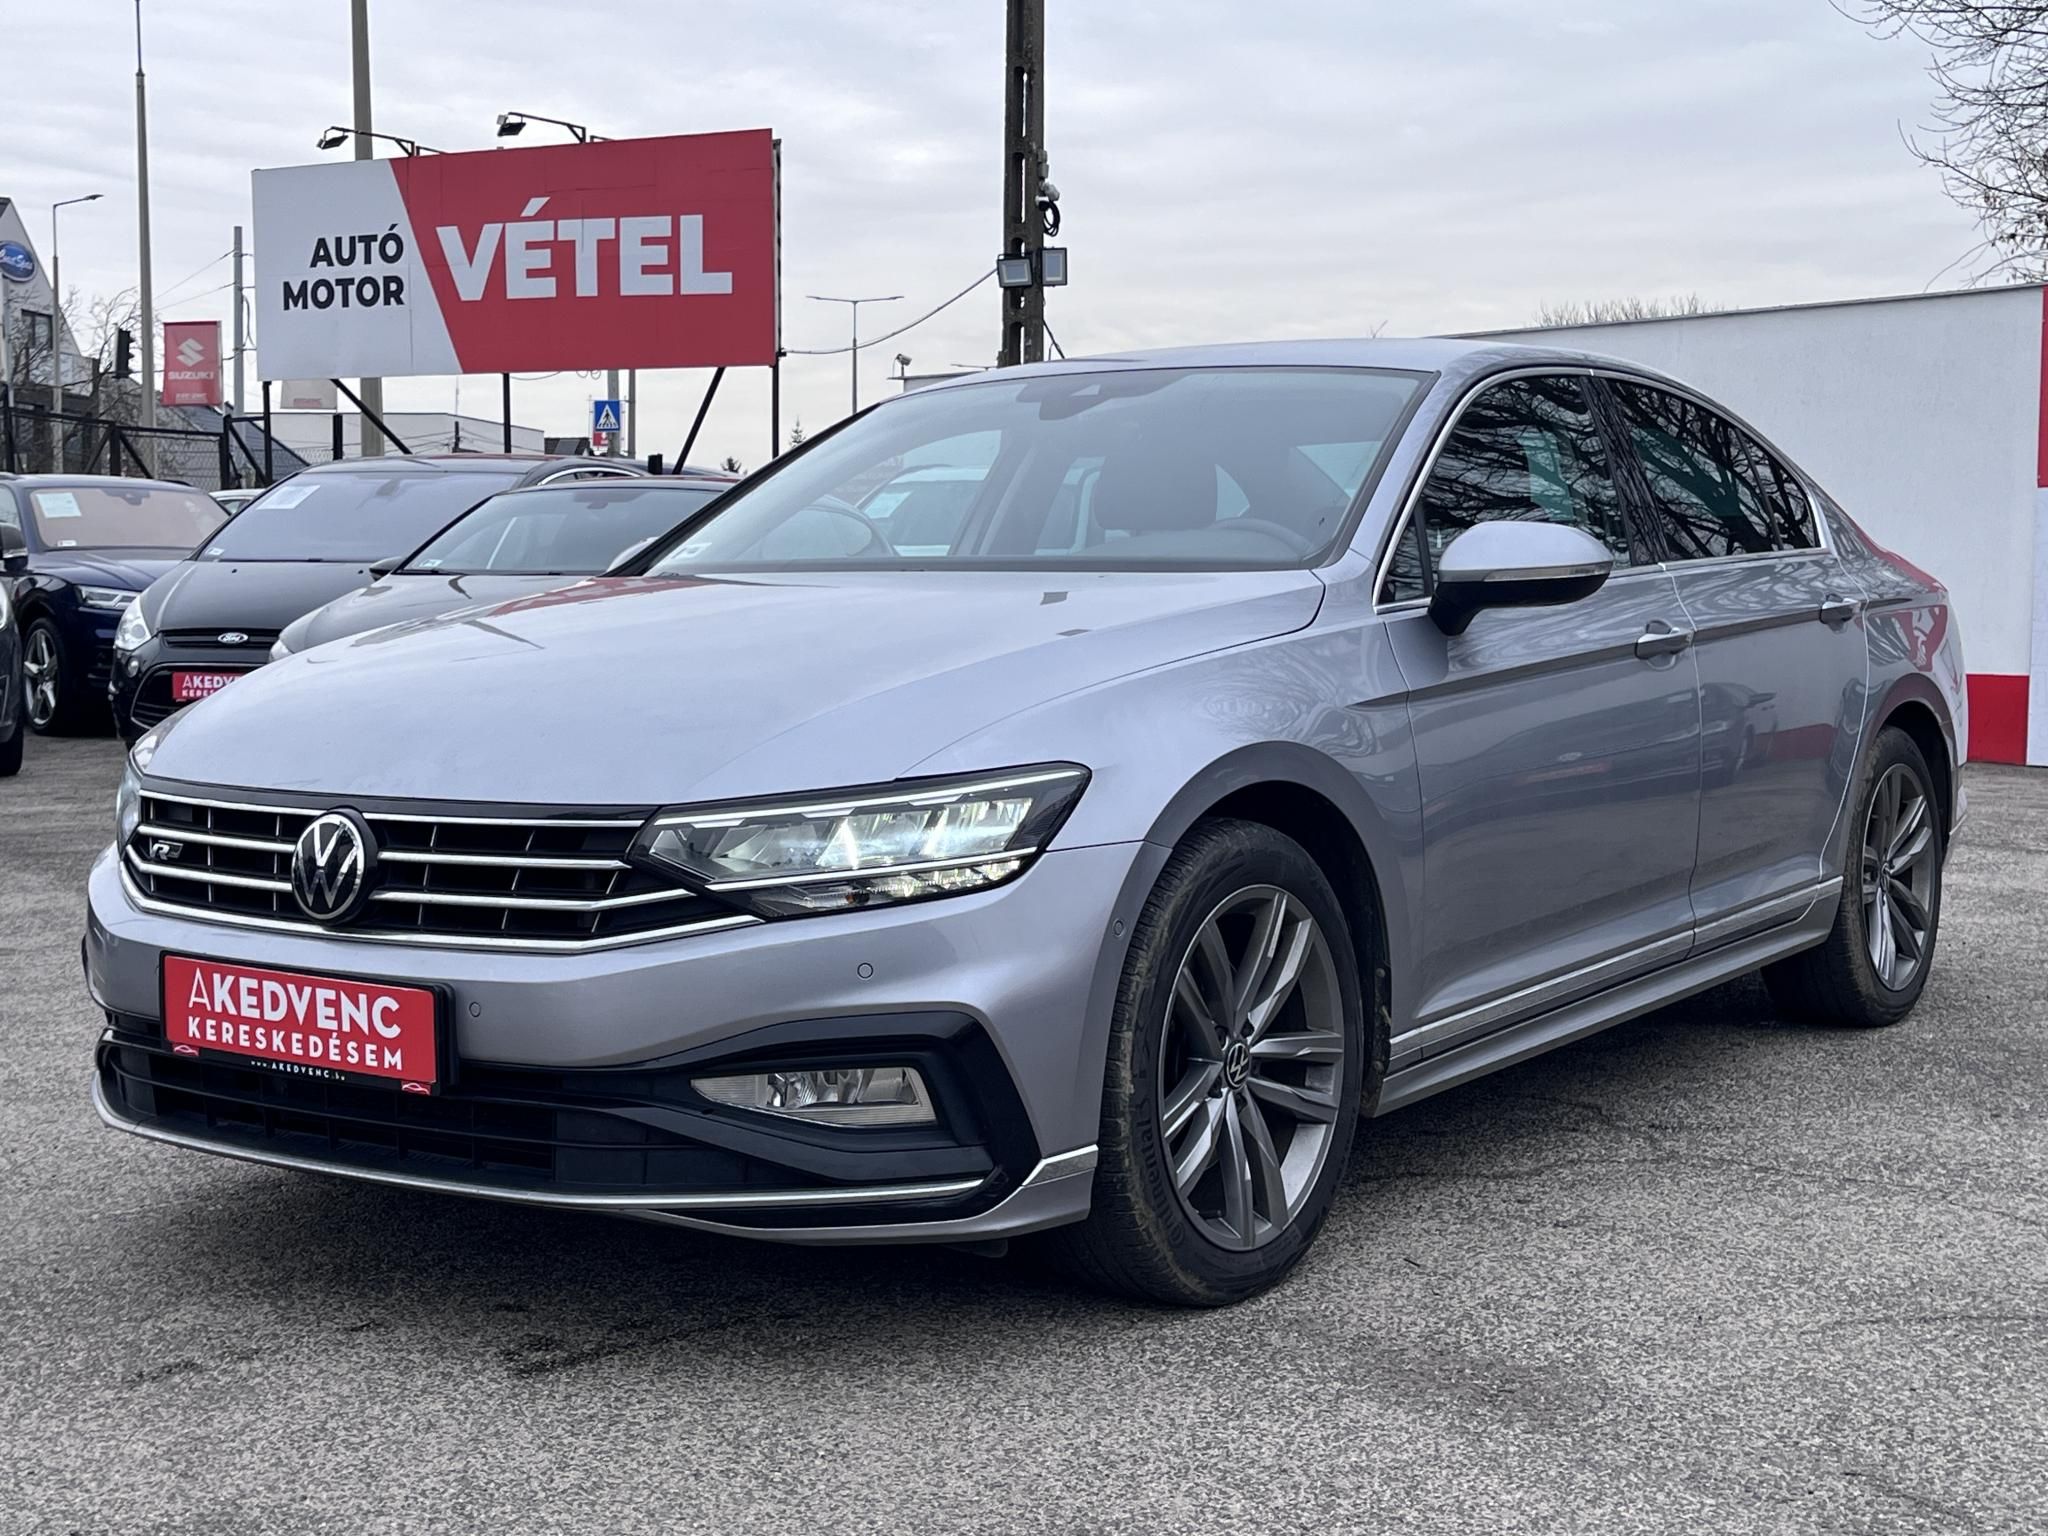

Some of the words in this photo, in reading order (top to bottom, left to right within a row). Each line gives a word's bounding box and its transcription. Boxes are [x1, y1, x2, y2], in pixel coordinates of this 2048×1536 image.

[309, 223, 404, 269] AUTÓ
[435, 196, 733, 302] VÉTEL
[282, 275, 405, 311] MOTOR
[167, 371, 214, 380] SUZUKI
[187, 1015, 403, 1071] KERESKEDÉSEM
